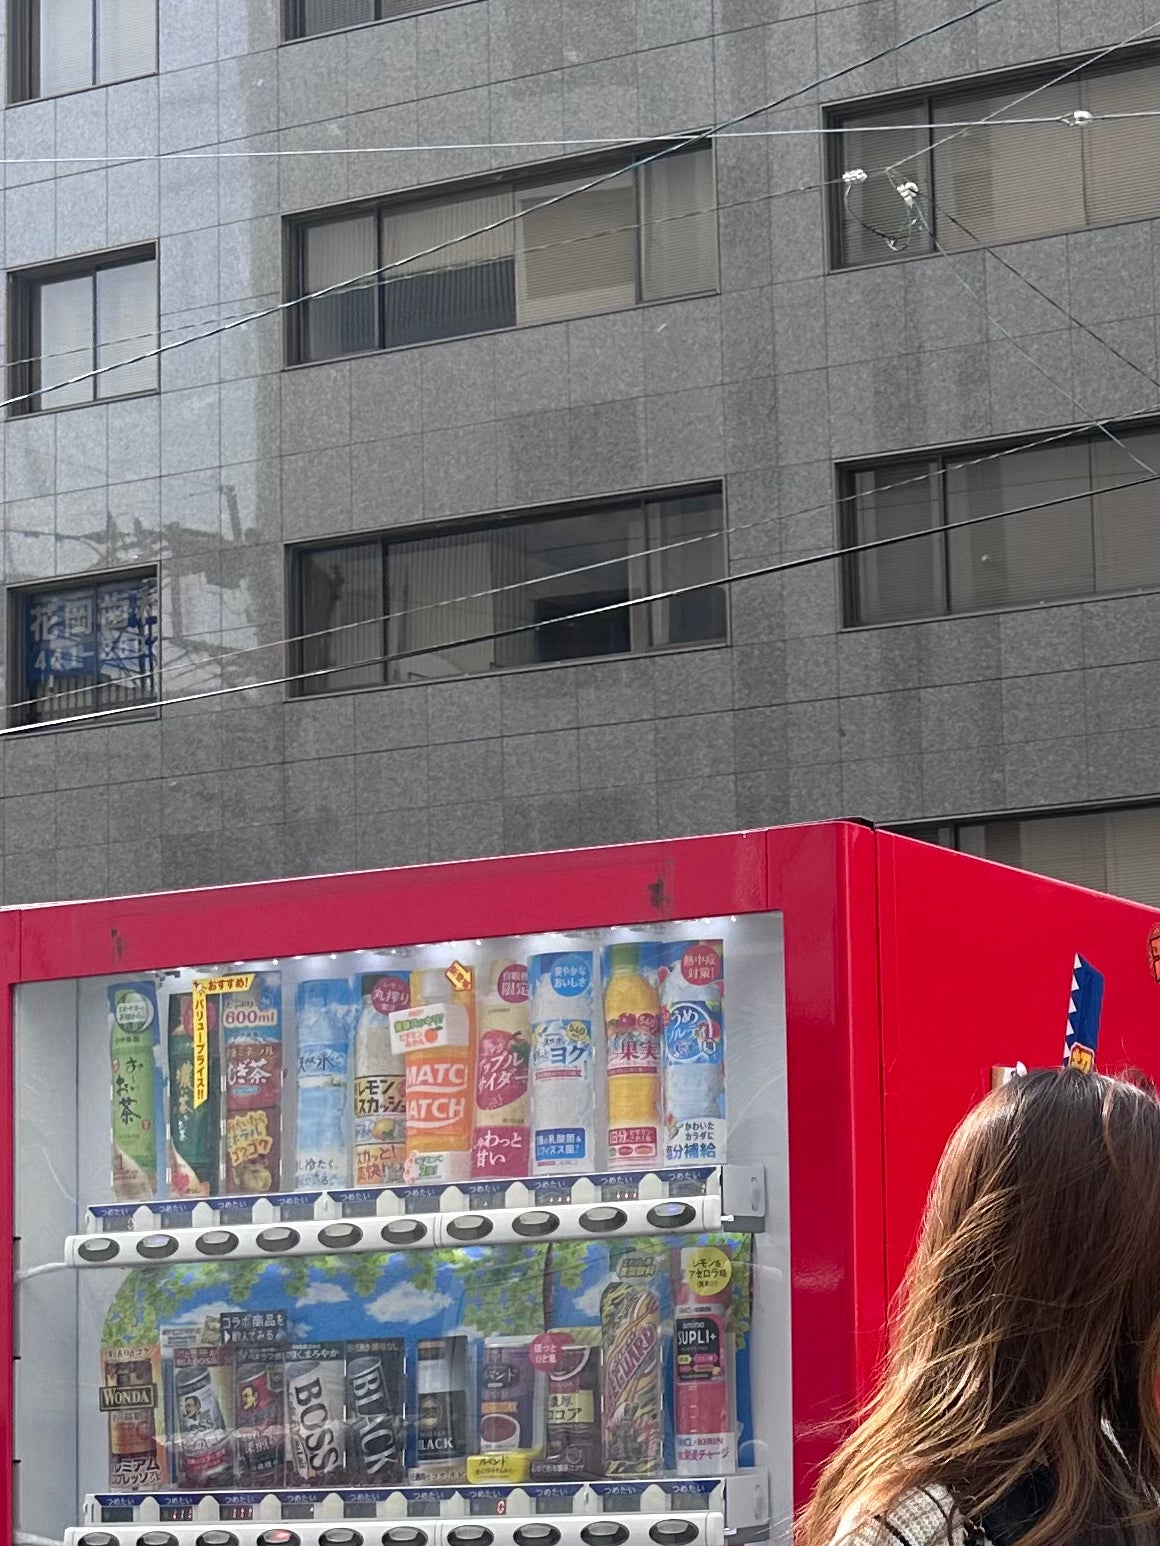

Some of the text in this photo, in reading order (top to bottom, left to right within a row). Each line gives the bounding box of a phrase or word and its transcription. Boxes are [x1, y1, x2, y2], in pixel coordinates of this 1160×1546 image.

[553, 977, 587, 988] おいしさ
[225, 1009, 275, 1025] 600ml
[670, 1009, 699, 1028] うめ
[406, 1063, 468, 1087] MATC
[357, 1079, 396, 1096] レモン
[406, 1097, 465, 1121] ATCH
[476, 1150, 506, 1168] 甘い
[600, 1176, 633, 1185] つめたい
[668, 1171, 701, 1181] つめたい
[469, 1184, 500, 1194] つめたい
[534, 1180, 566, 1190] つめたい
[340, 1192, 371, 1202] つめたい
[404, 1188, 435, 1198] つめたい
[217, 1200, 247, 1210] つめたい
[278, 1196, 309, 1205] つめたい
[101, 1207, 129, 1217] つめたい
[158, 1204, 187, 1214] つめたい
[222, 1313, 285, 1329] コラボ商品を
[102, 1388, 150, 1406] WONDA
[294, 1377, 339, 1471] BOSS
[352, 1369, 398, 1475] BLACK
[535, 1487, 568, 1496] つめたい
[603, 1485, 637, 1495] つめたい
[671, 1484, 705, 1494] つめたい
[286, 1494, 317, 1503] つめたい
[350, 1493, 379, 1501] つめたい
[413, 1491, 444, 1500] つめたい
[468, 1490, 501, 1499] つめたい
[107, 1497, 133, 1505] つめたい
[164, 1497, 193, 1505] つめたい
[224, 1496, 254, 1505] つめたい
